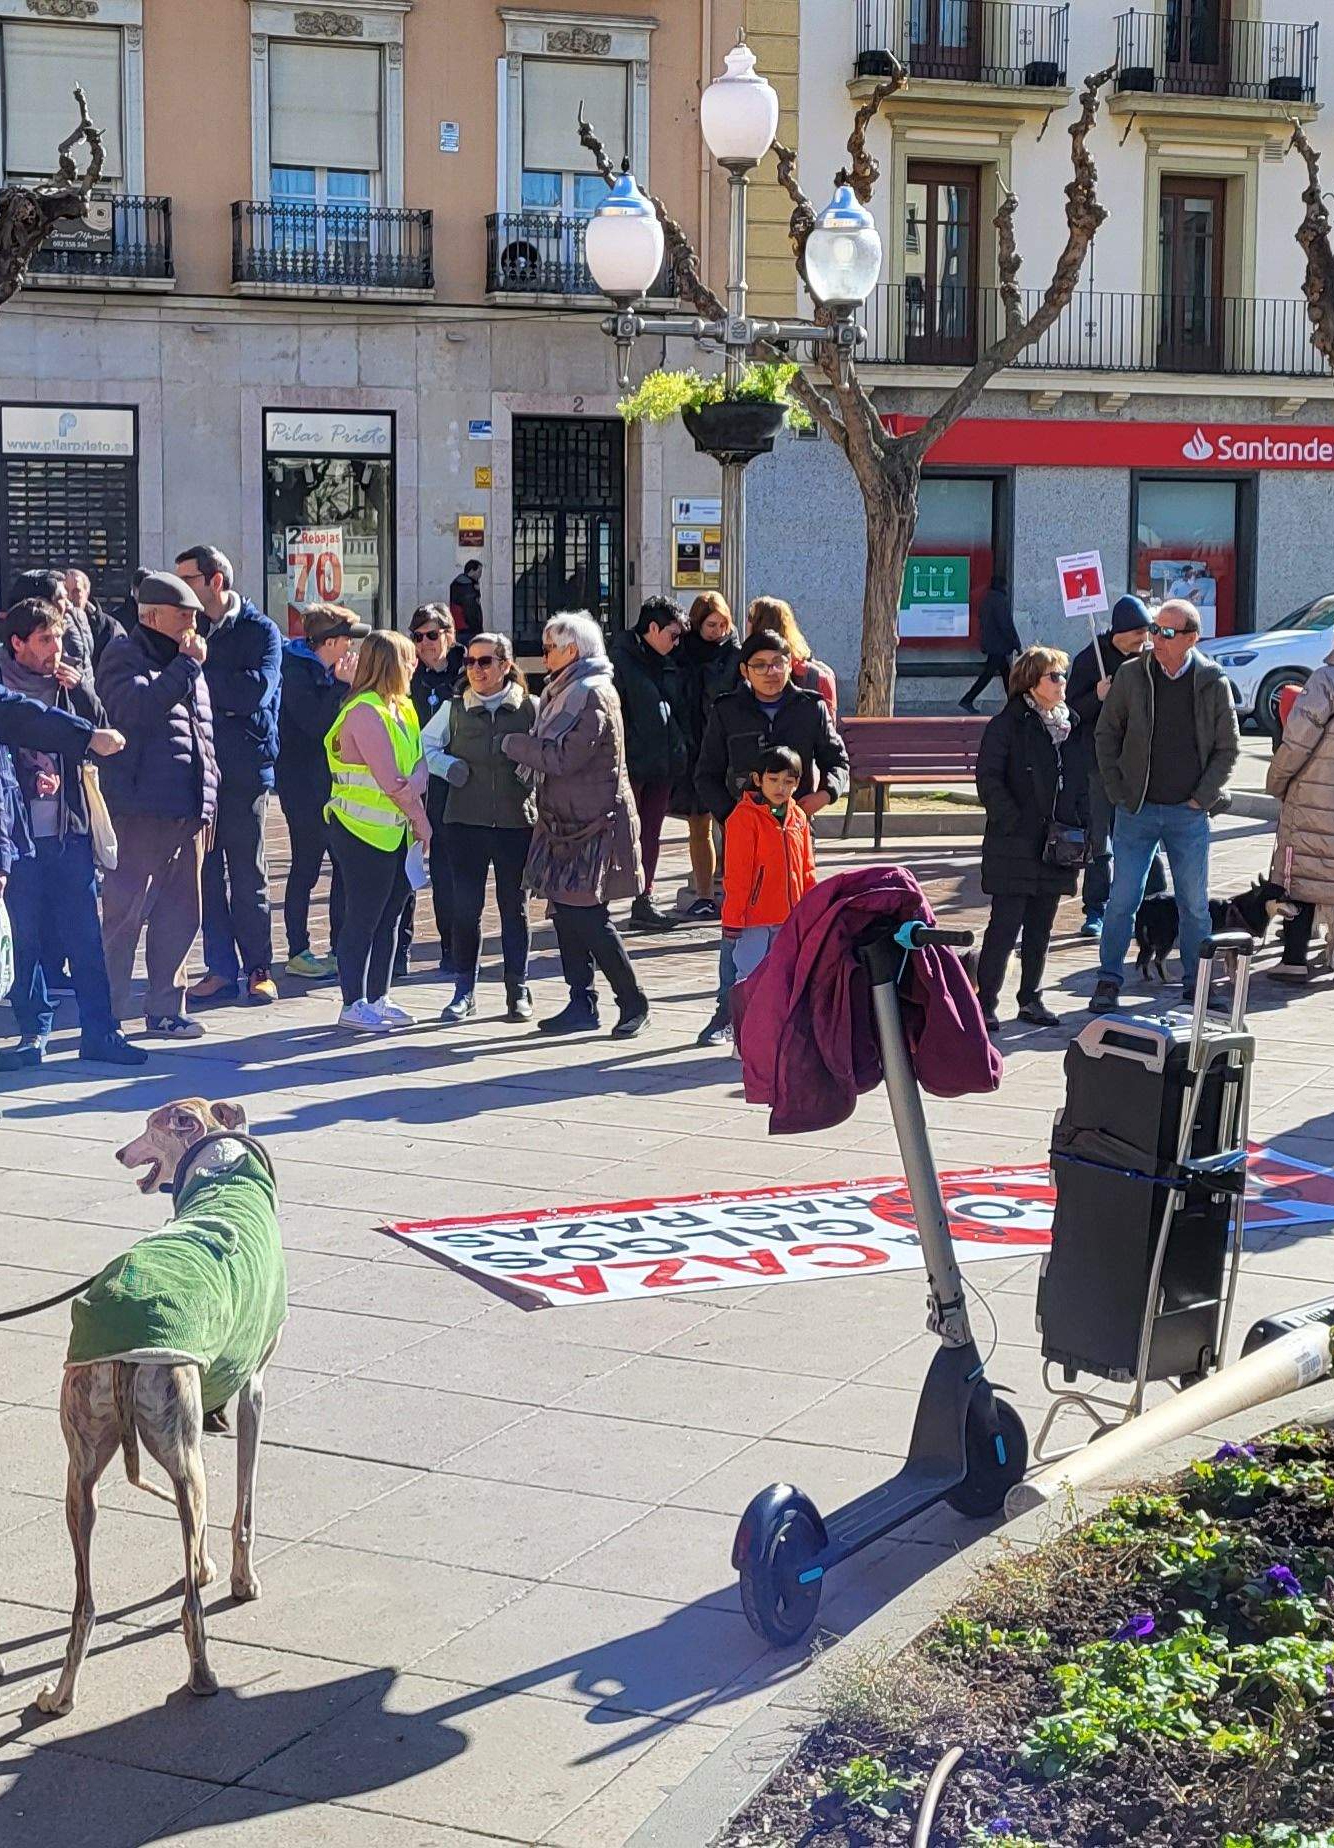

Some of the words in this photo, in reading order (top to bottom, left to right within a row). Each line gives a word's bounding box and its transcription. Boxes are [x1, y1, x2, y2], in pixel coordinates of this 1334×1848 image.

[573, 396, 584, 412] 2
[271, 422, 323, 443] Pilar
[331, 424, 386, 443] Prieto
[302, 532, 340, 546] Rebajas
[289, 552, 342, 602] 70
[433, 1211, 712, 1249] RAZAS
[472, 1219, 874, 1270] GALGOS
[506, 1243, 891, 1296] CAZA
